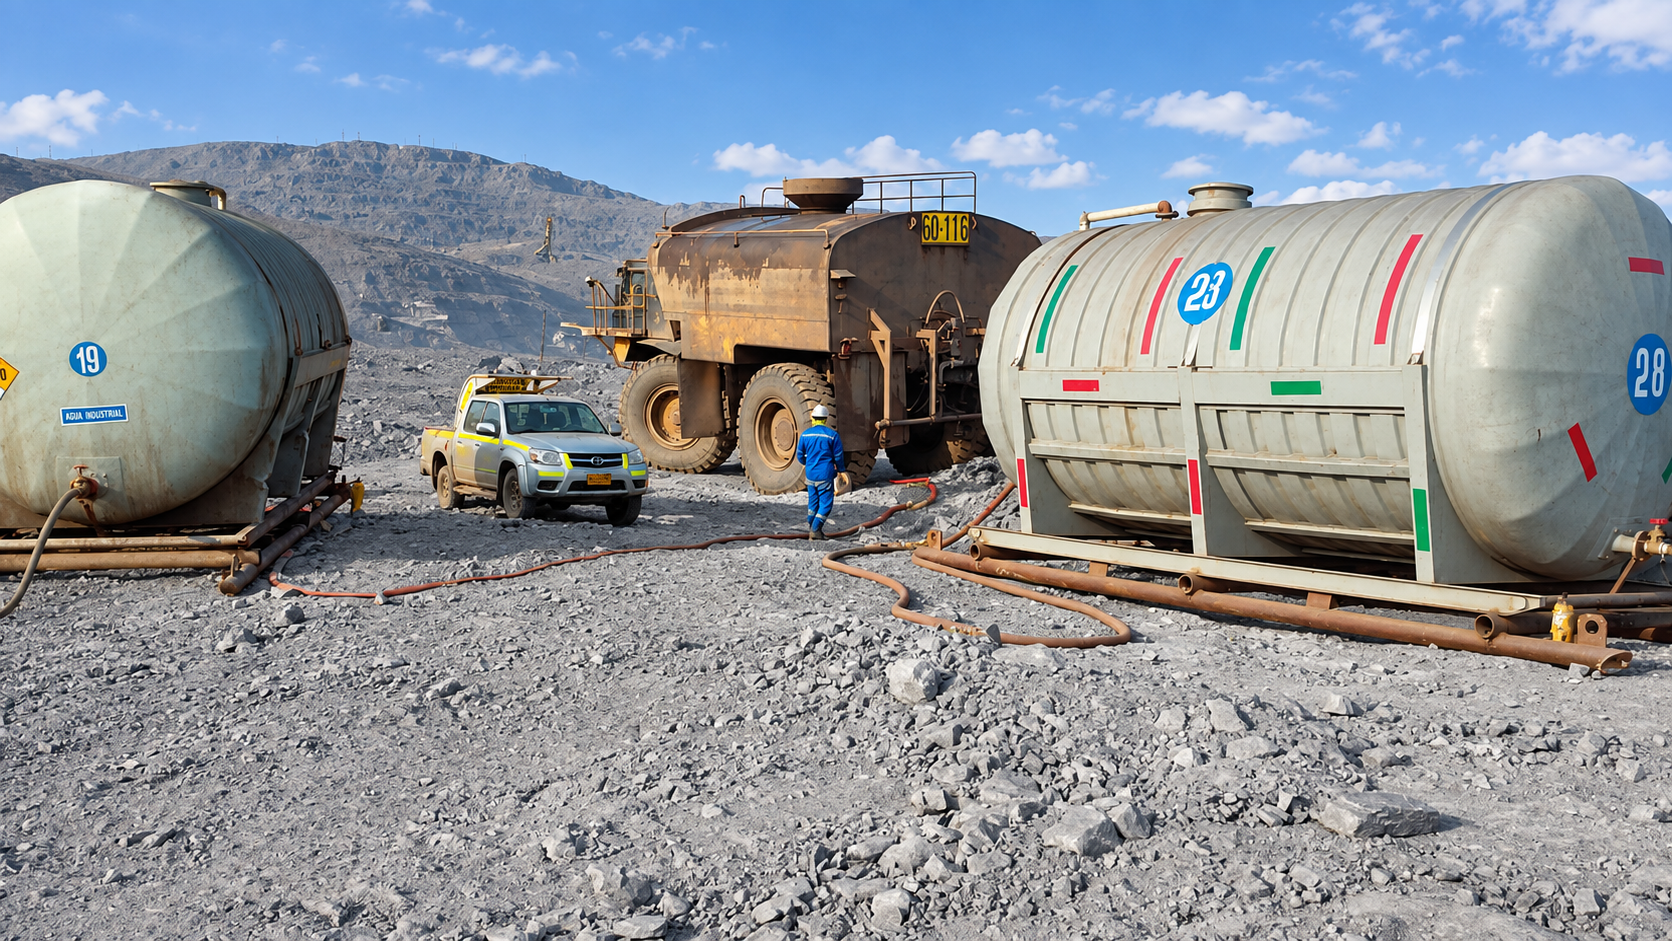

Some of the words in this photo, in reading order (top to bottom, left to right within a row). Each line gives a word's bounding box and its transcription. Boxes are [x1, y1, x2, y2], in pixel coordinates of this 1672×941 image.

[1183, 269, 1226, 312] 23
[76, 345, 100, 374] 19
[1634, 347, 1666, 397] 28
[85, 409, 123, 420] INDUSTRIAL
